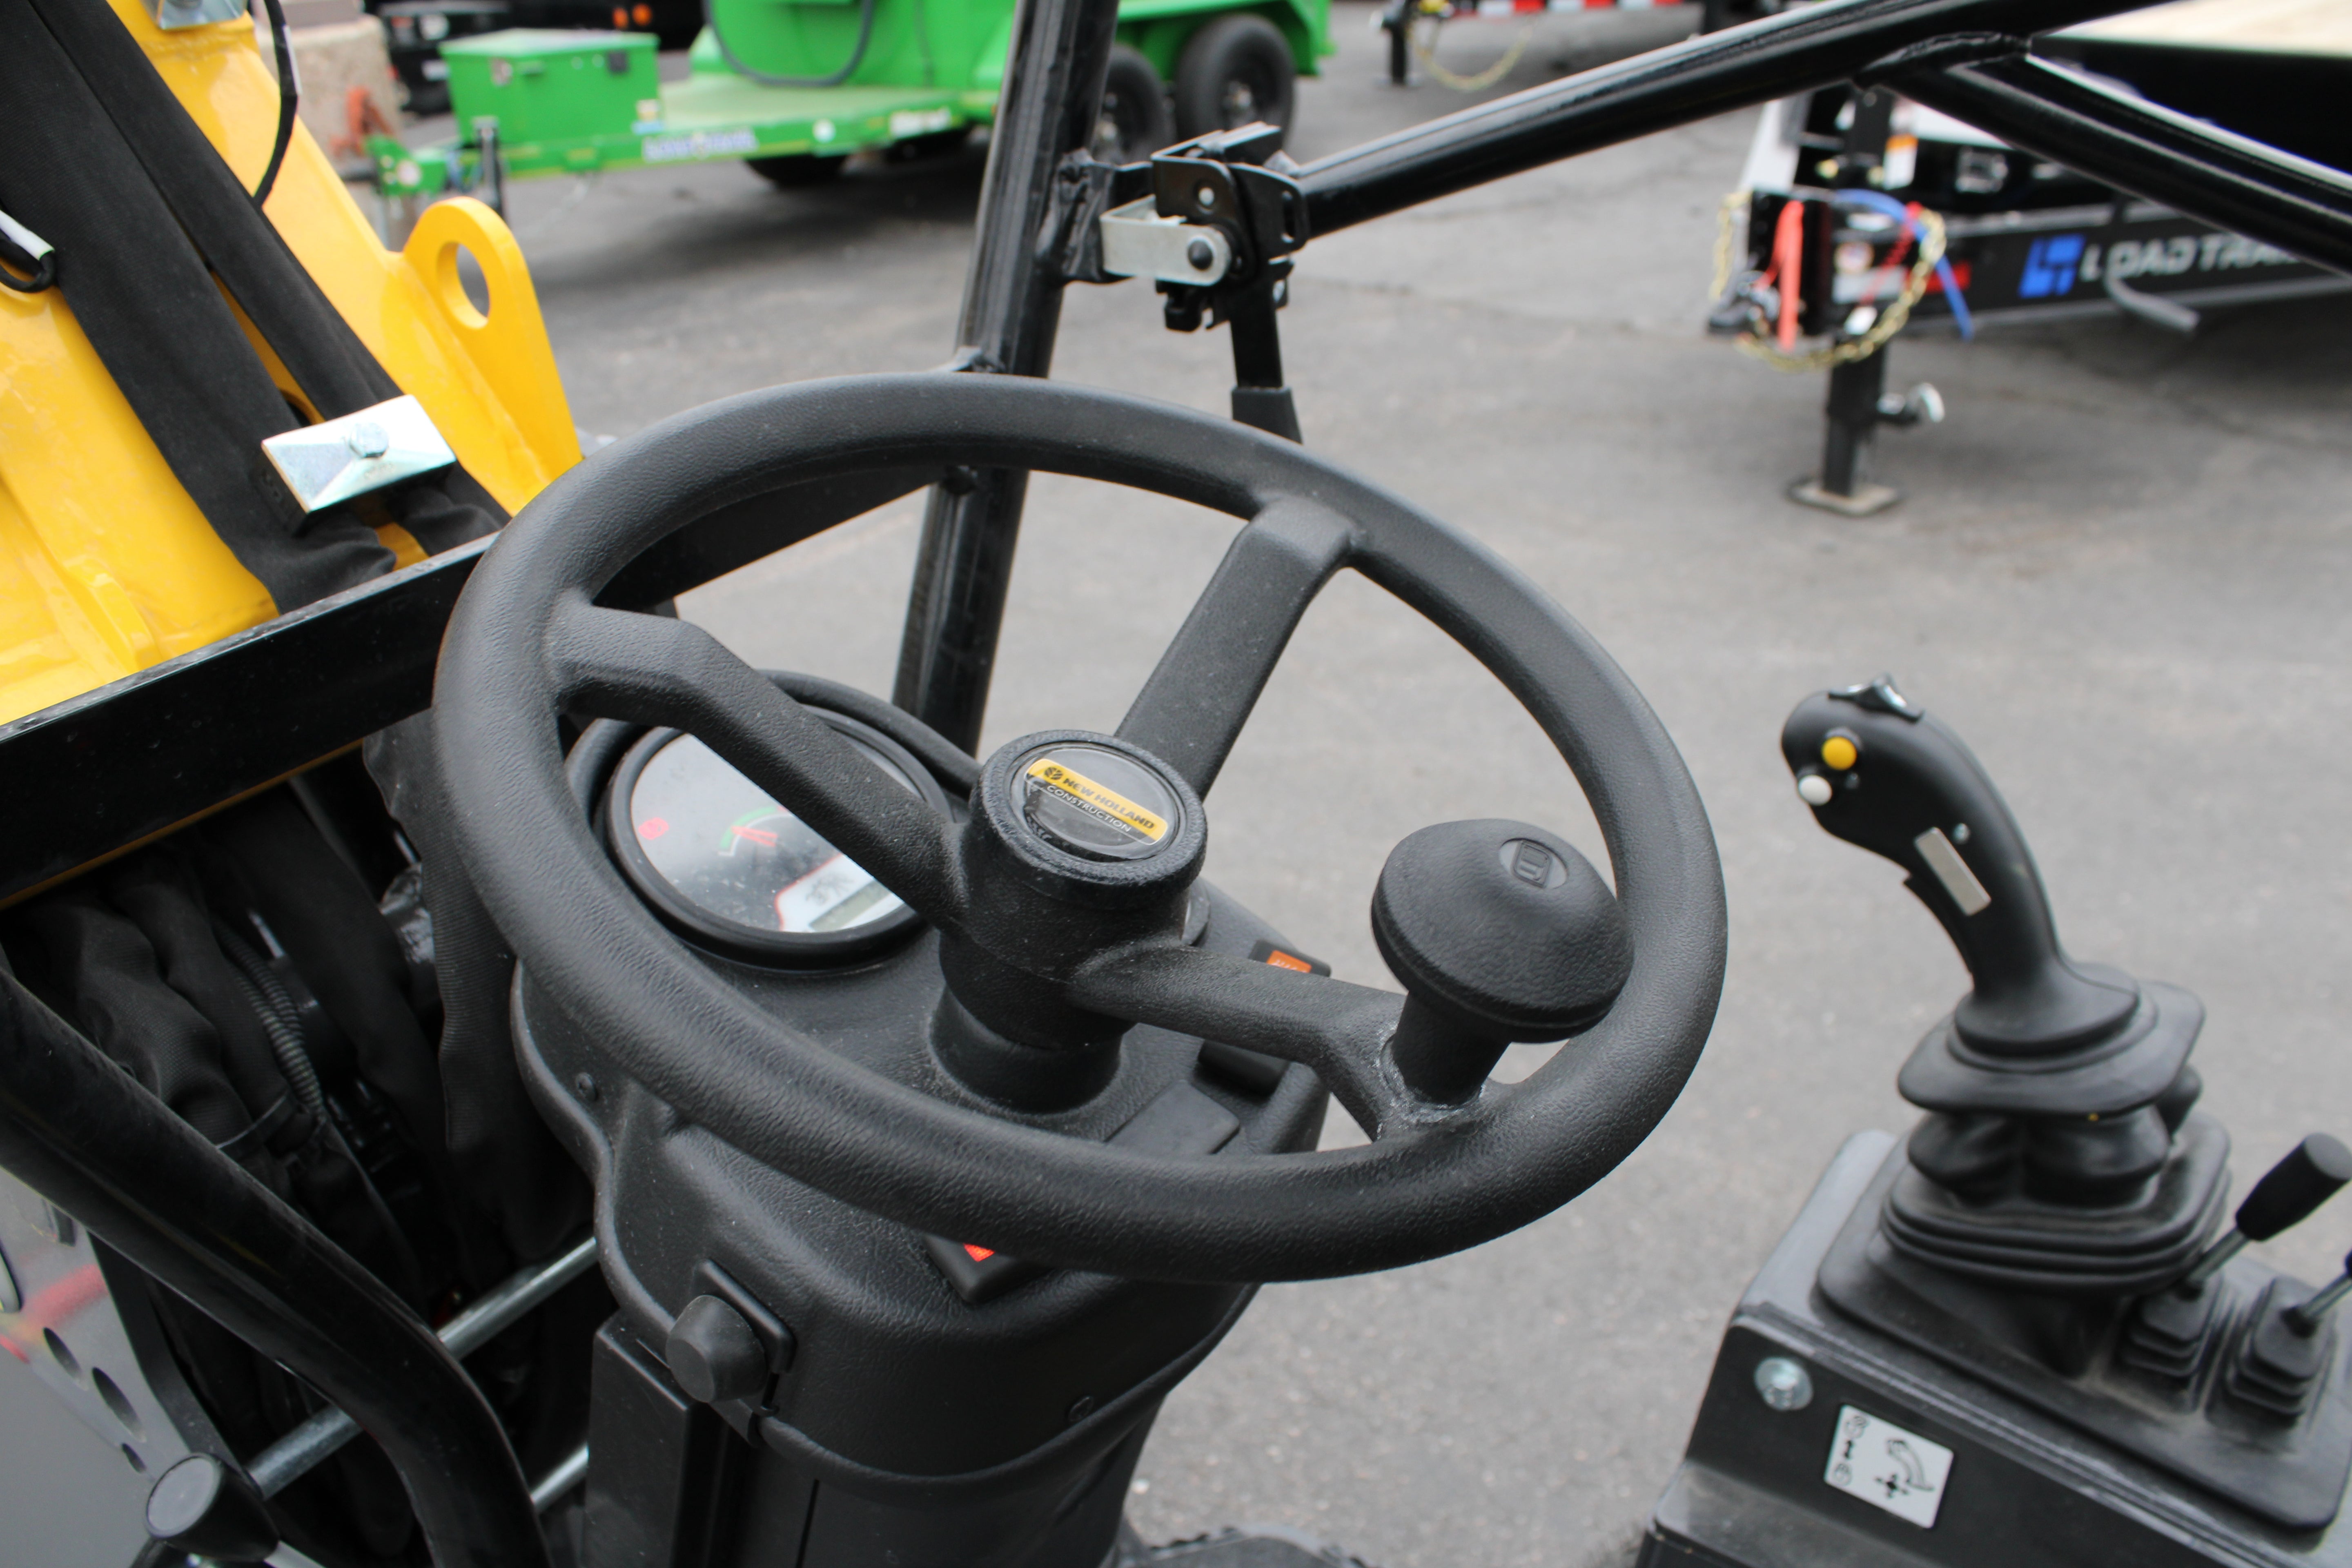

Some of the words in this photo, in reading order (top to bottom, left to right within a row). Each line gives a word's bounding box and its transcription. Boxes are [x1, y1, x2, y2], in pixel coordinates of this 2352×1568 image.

[1047, 785, 1132, 833] CONSTRUCTION
[1062, 778, 1095, 797] NEW
[1094, 794, 1155, 829] HOLLAND
